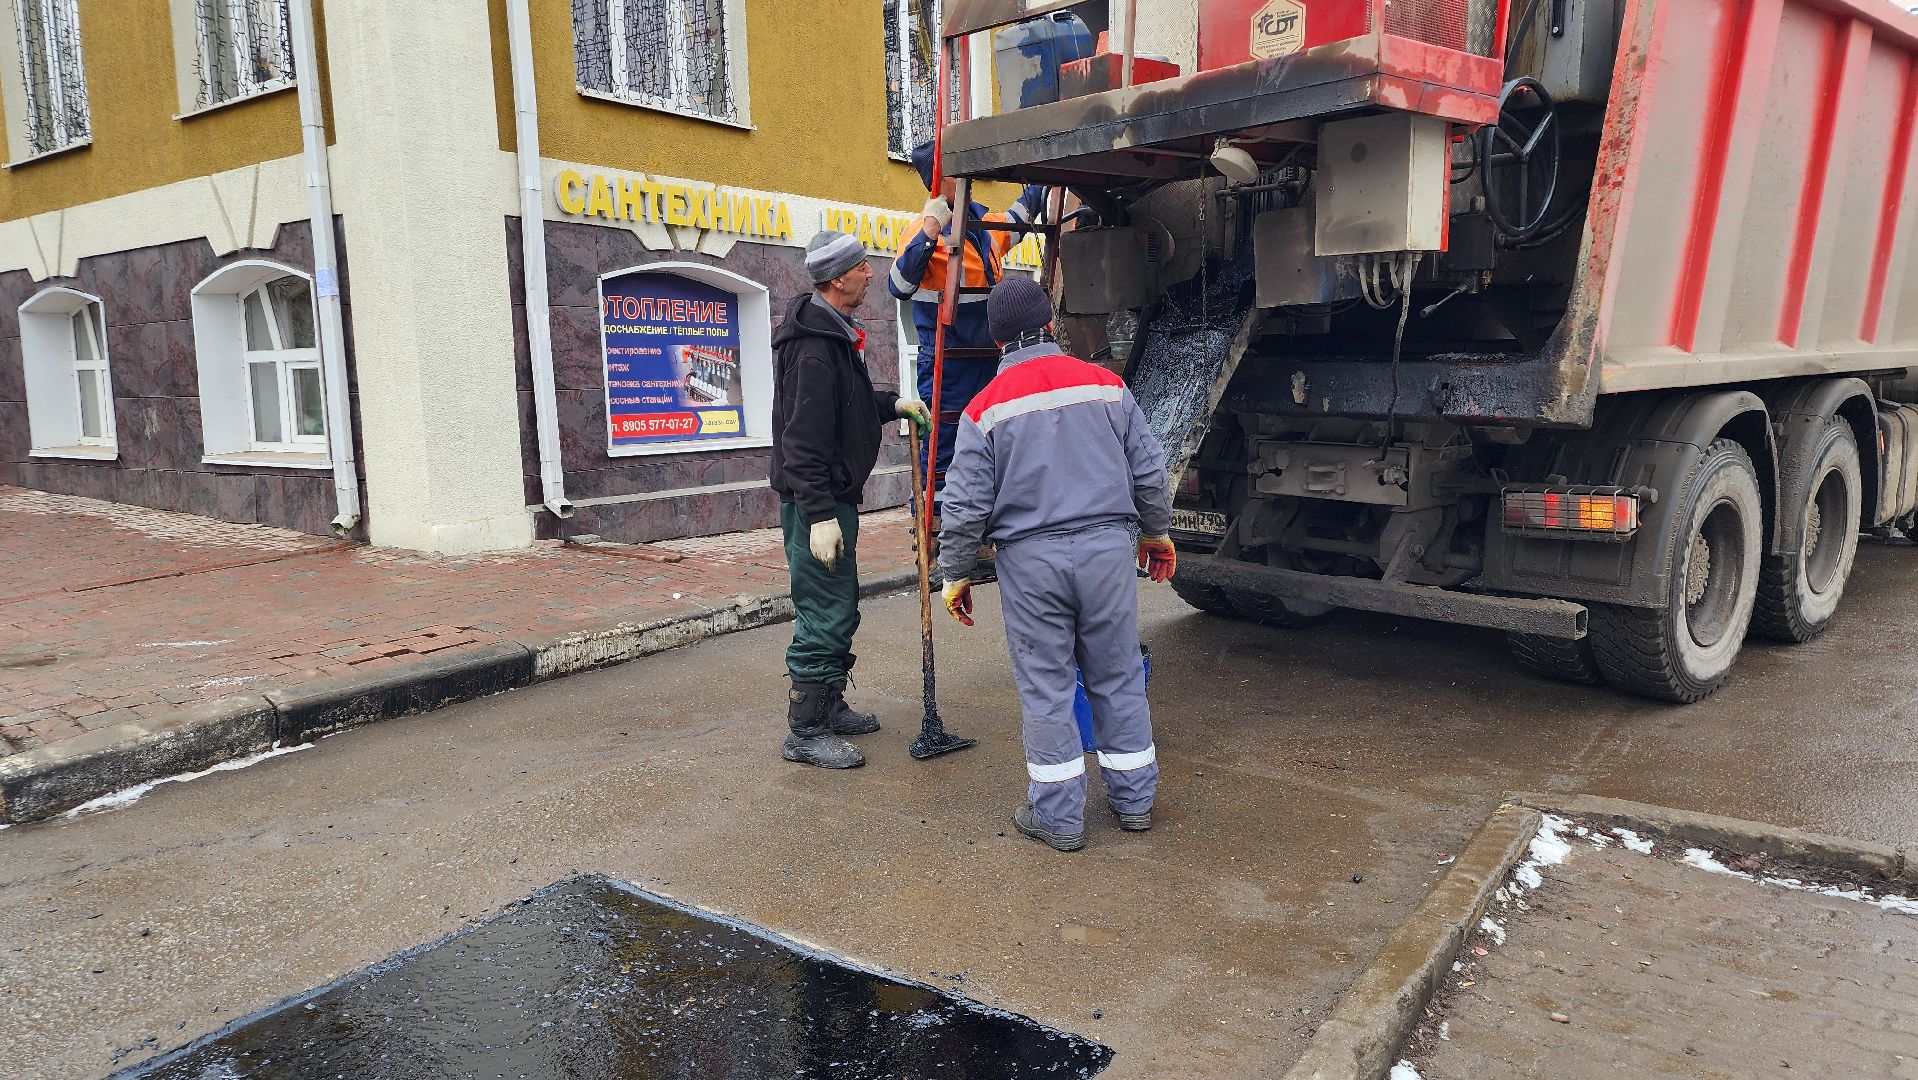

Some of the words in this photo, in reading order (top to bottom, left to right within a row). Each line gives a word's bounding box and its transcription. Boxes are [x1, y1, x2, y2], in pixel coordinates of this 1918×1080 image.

[557, 169, 794, 239] САНТЕХНИКА
[673, 325, 705, 336] ТЁПЛЫЕ
[706, 327, 729, 337] ПОЛЫ
[607, 346, 662, 357] оектирование
[622, 420, 647, 432] 8905
[648, 418, 694, 430] 577-07-27
